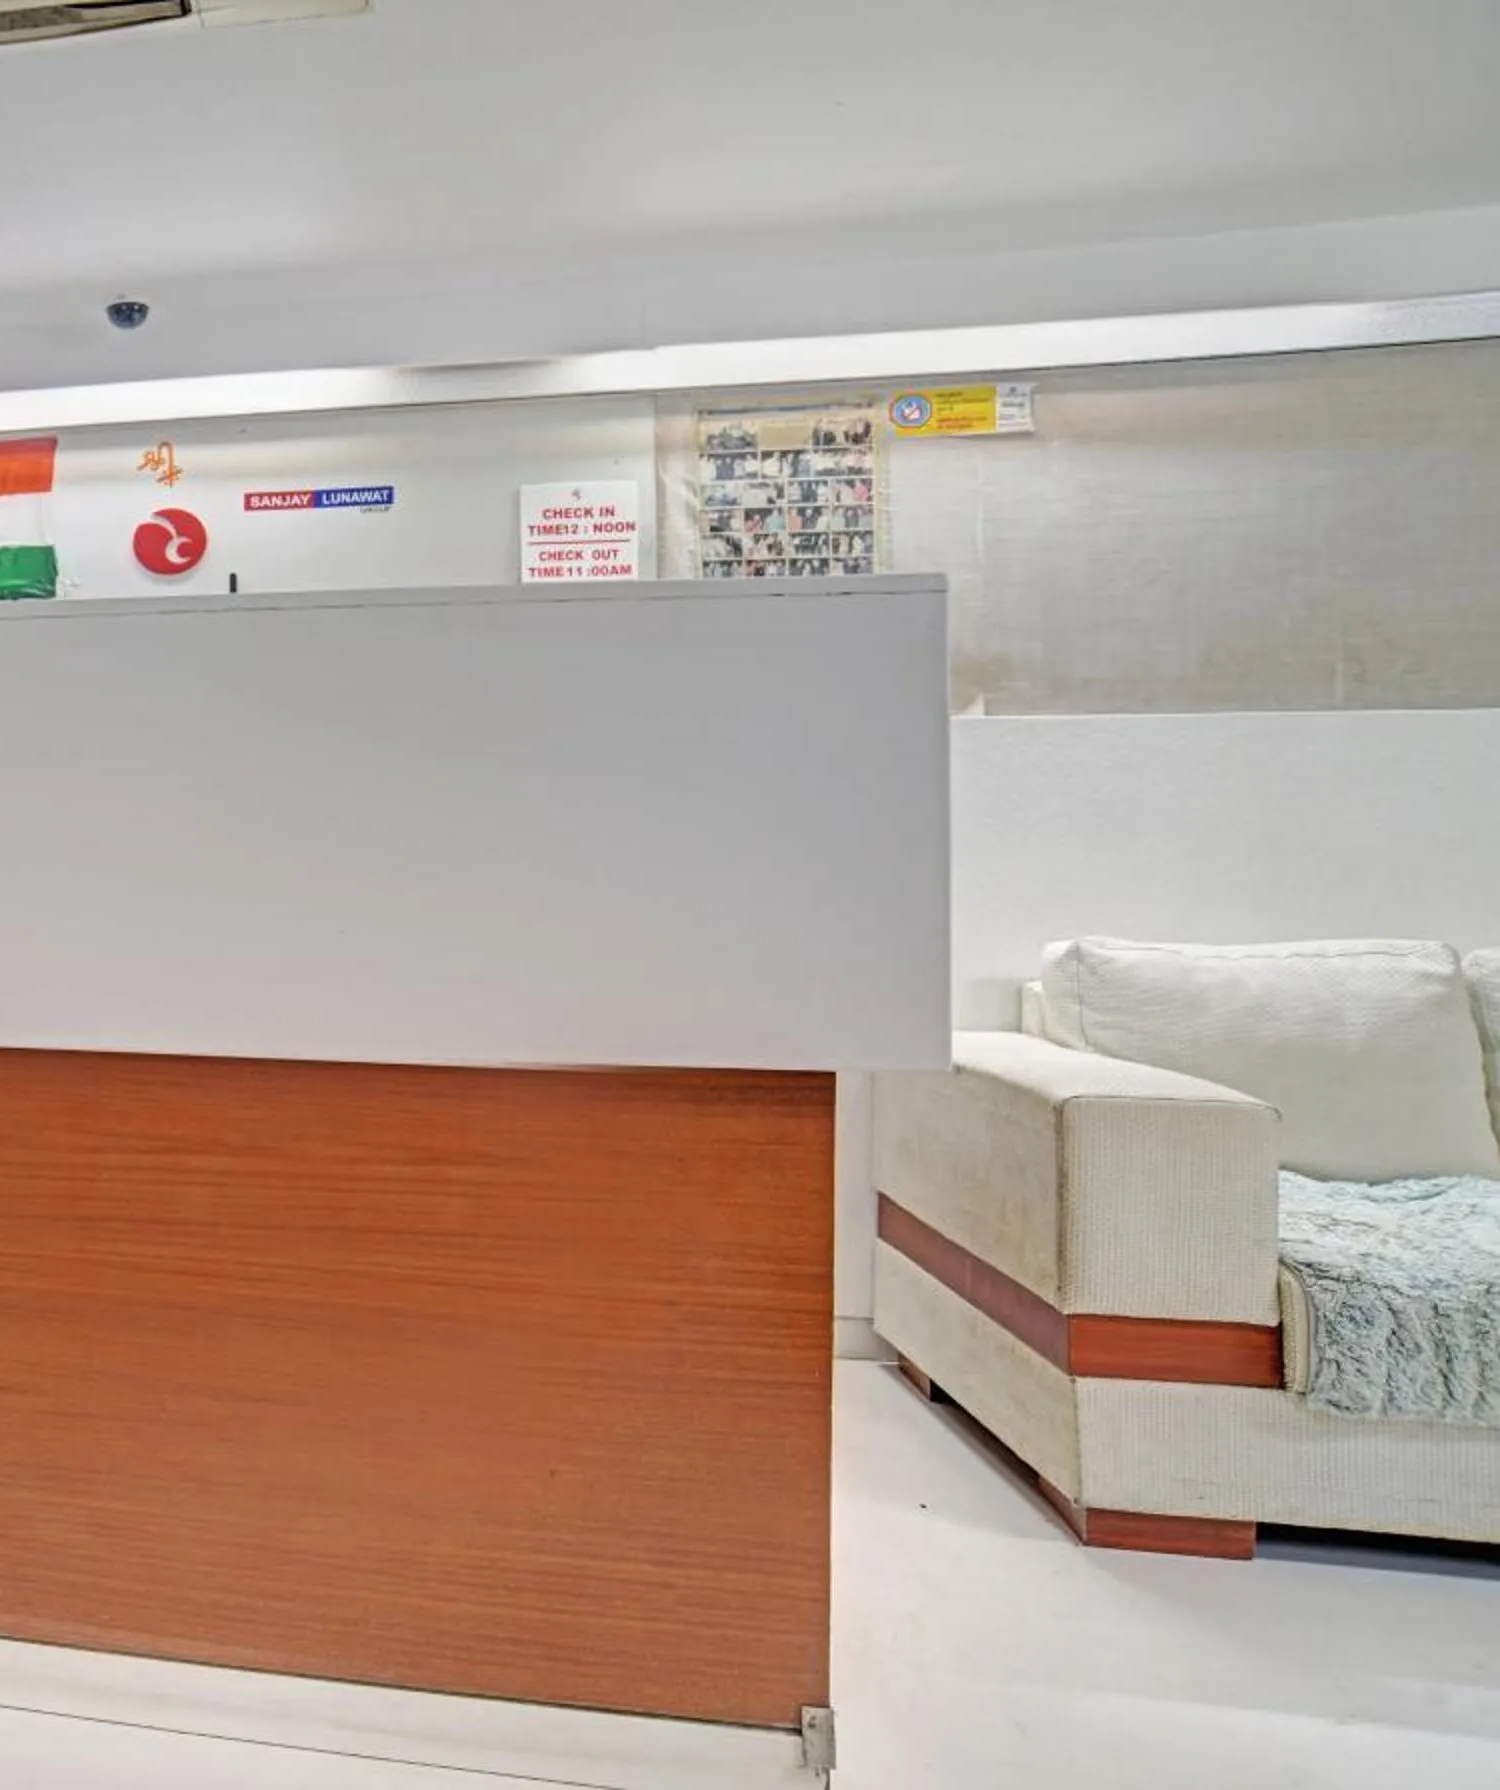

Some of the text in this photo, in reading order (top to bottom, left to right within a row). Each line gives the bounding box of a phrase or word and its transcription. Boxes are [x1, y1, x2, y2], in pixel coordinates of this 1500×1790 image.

[250, 490, 390, 509] SANJAY LUNAWAT
[542, 505, 616, 520] CHECK IN
[593, 521, 637, 533] NOON
[538, 549, 620, 561] CHECK OUT
